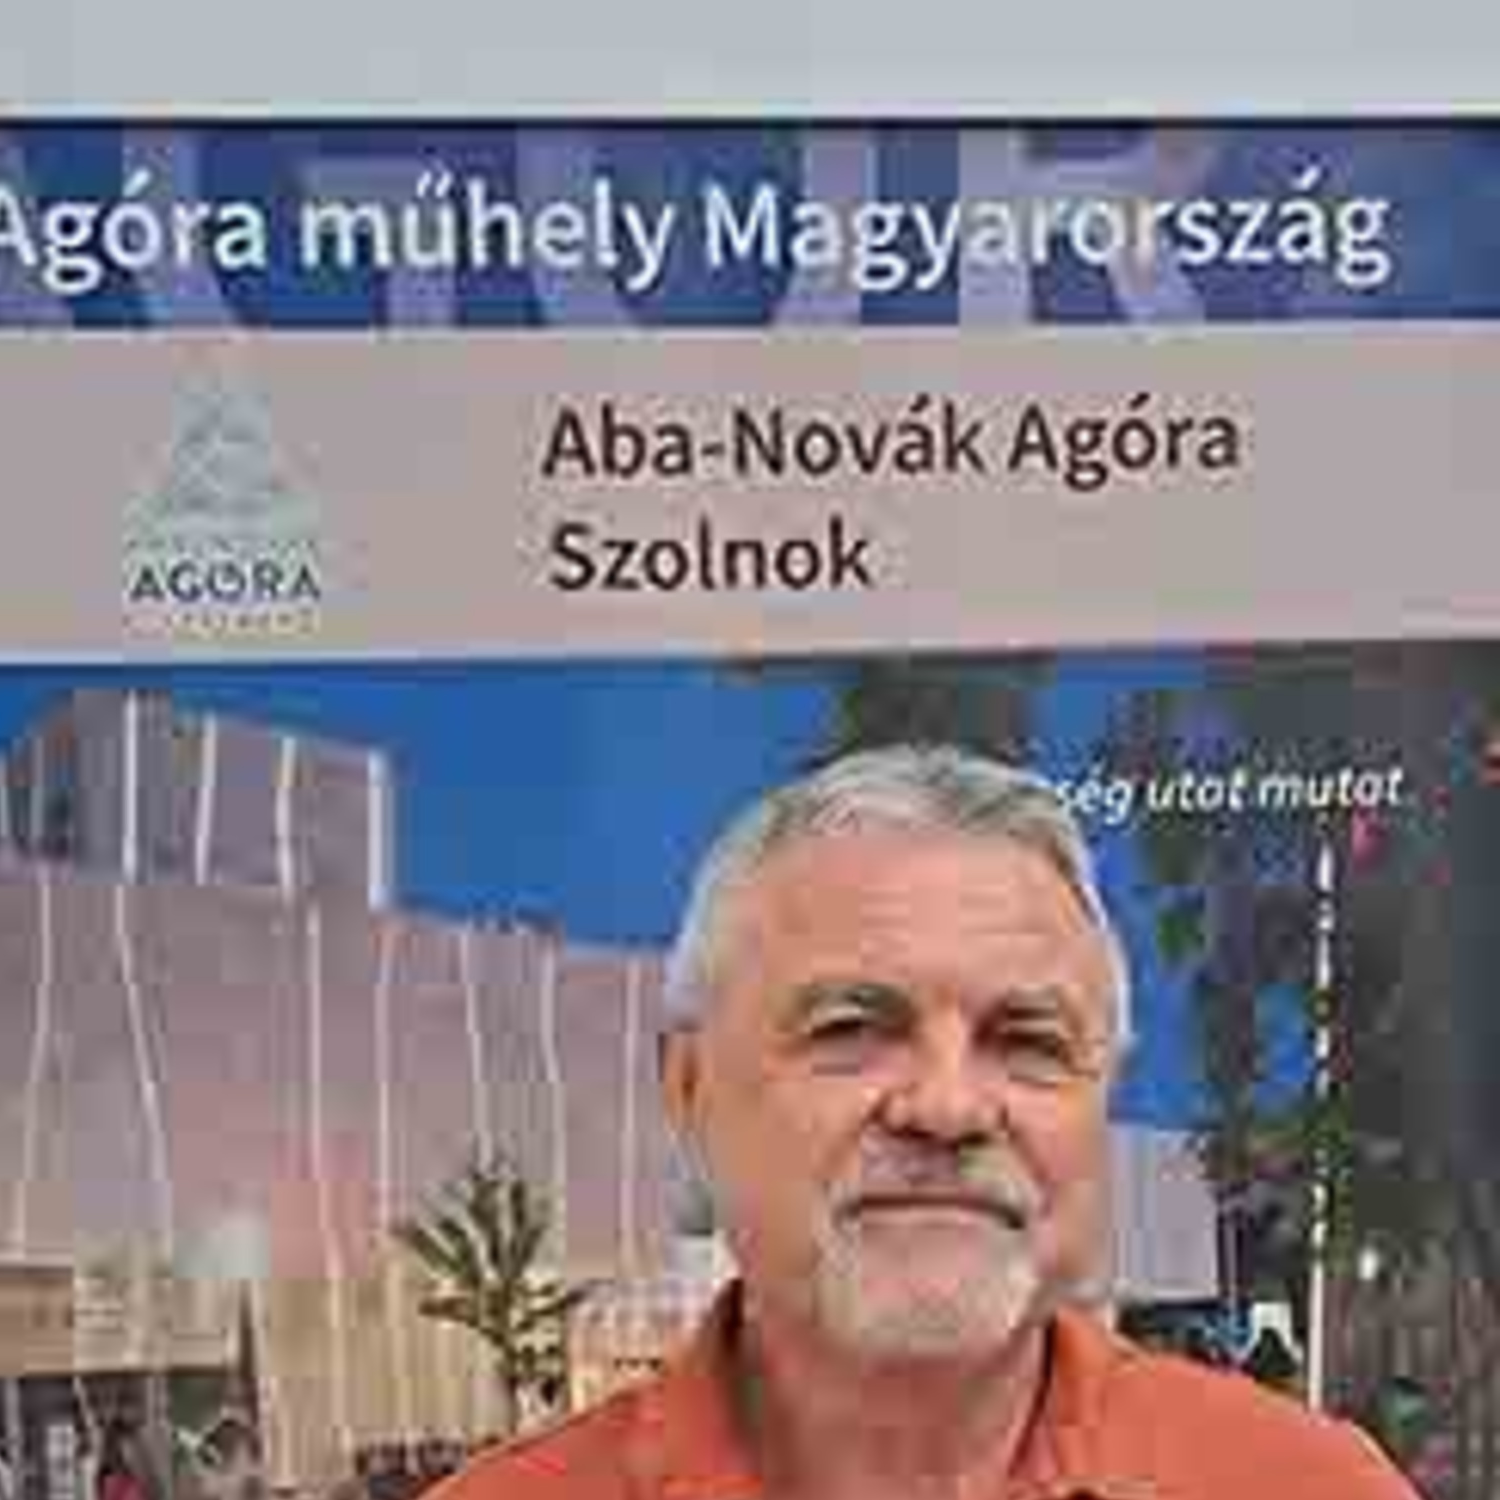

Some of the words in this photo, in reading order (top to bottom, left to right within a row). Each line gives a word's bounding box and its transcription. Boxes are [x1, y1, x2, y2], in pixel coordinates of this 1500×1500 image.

[301, 160, 675, 288] műhely
[703, 165, 1393, 290] Magyarország
[541, 392, 986, 478] Aba-Novák
[1007, 392, 1241, 492] Agóra
[549, 513, 875, 592] Szolnok
[1055, 763, 1134, 825] ség
[1146, 765, 1249, 813] utat
[1257, 764, 1404, 810] mutat
